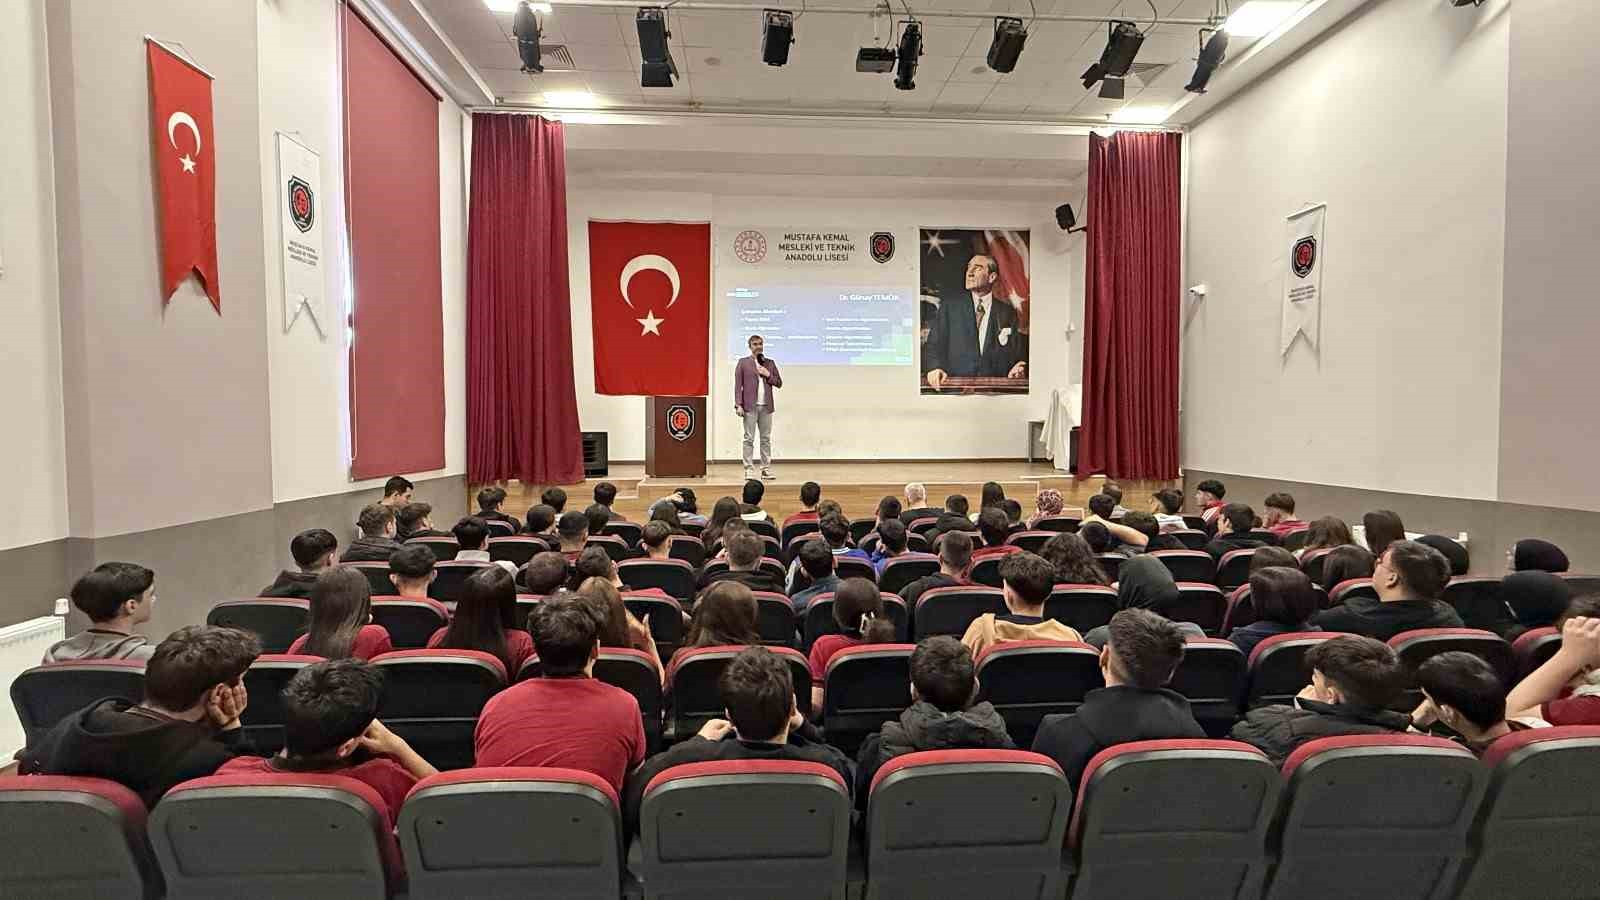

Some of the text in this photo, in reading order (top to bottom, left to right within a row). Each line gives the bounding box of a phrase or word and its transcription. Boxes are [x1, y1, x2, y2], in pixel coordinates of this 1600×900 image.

[778, 243, 856, 251] MESLEKİ VE TEKNİK
[824, 253, 849, 261] LİSESİ
